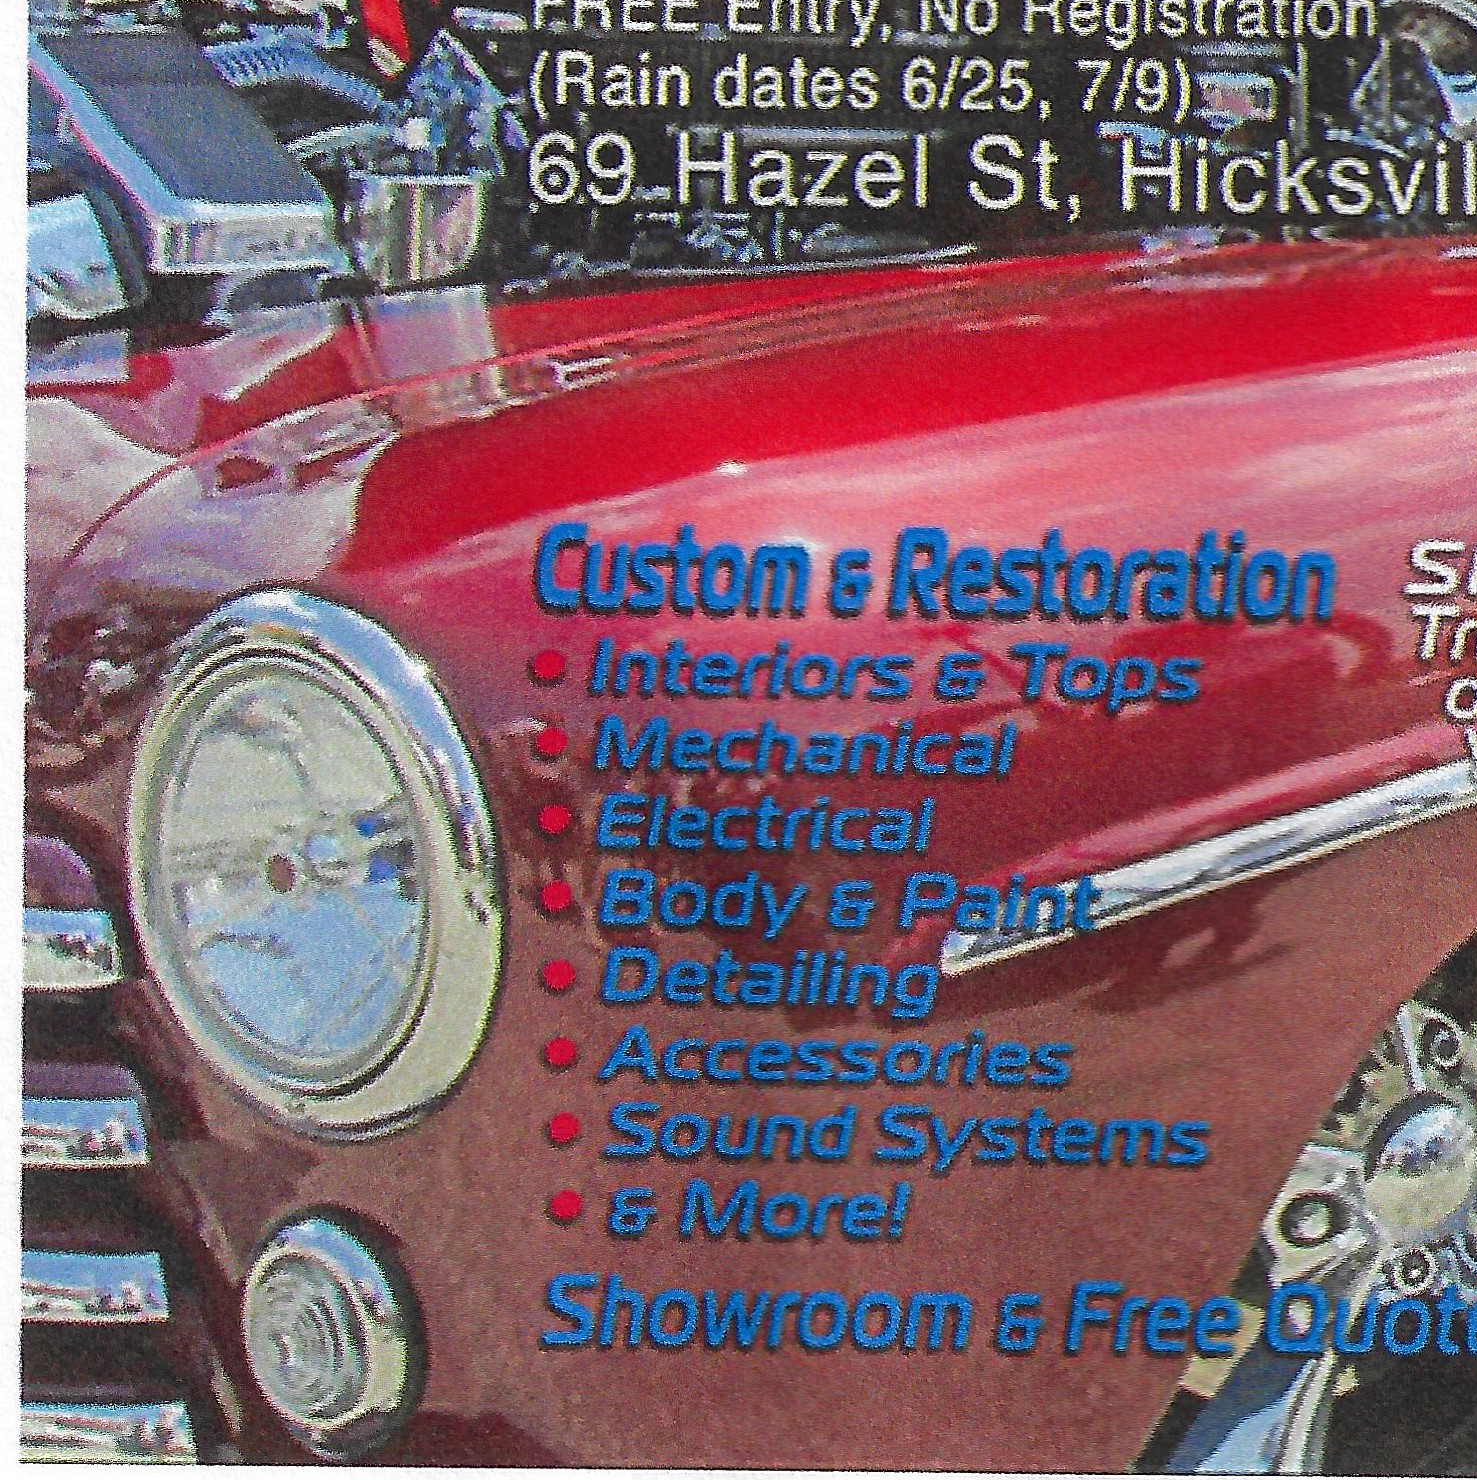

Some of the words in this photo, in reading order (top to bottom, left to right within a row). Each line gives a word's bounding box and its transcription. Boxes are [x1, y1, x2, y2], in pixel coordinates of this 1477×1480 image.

[530, 50, 691, 120] (Rain
[713, 52, 879, 110] dates
[903, 56, 1051, 121] 6/25,
[1076, 57, 1190, 124] 7/9)
[529, 131, 636, 206] 69
[676, 131, 930, 208] Hazel
[967, 132, 1081, 221] St,
[535, 522, 811, 618] Custom
[830, 548, 872, 617] &
[888, 525, 1337, 622] Restoration
[591, 638, 914, 700] Interiors
[936, 650, 984, 700] &
[1010, 643, 1202, 712] Tops
[595, 716, 1017, 775] Mechanical
[596, 794, 935, 854] Electrical
[602, 868, 807, 940] Body
[829, 880, 873, 930] &
[899, 870, 1103, 933] Paint
[603, 947, 942, 1019] Detailing
[600, 1025, 1076, 1086] Accessories
[605, 1101, 857, 1161] Sound
[875, 1104, 1211, 1172] Systems
[610, 1187, 655, 1235] &
[679, 1179, 911, 1238] More!
[542, 1273, 973, 1351] Showroom
[999, 1294, 1043, 1351] &
[1066, 1280, 1242, 1355] Free
